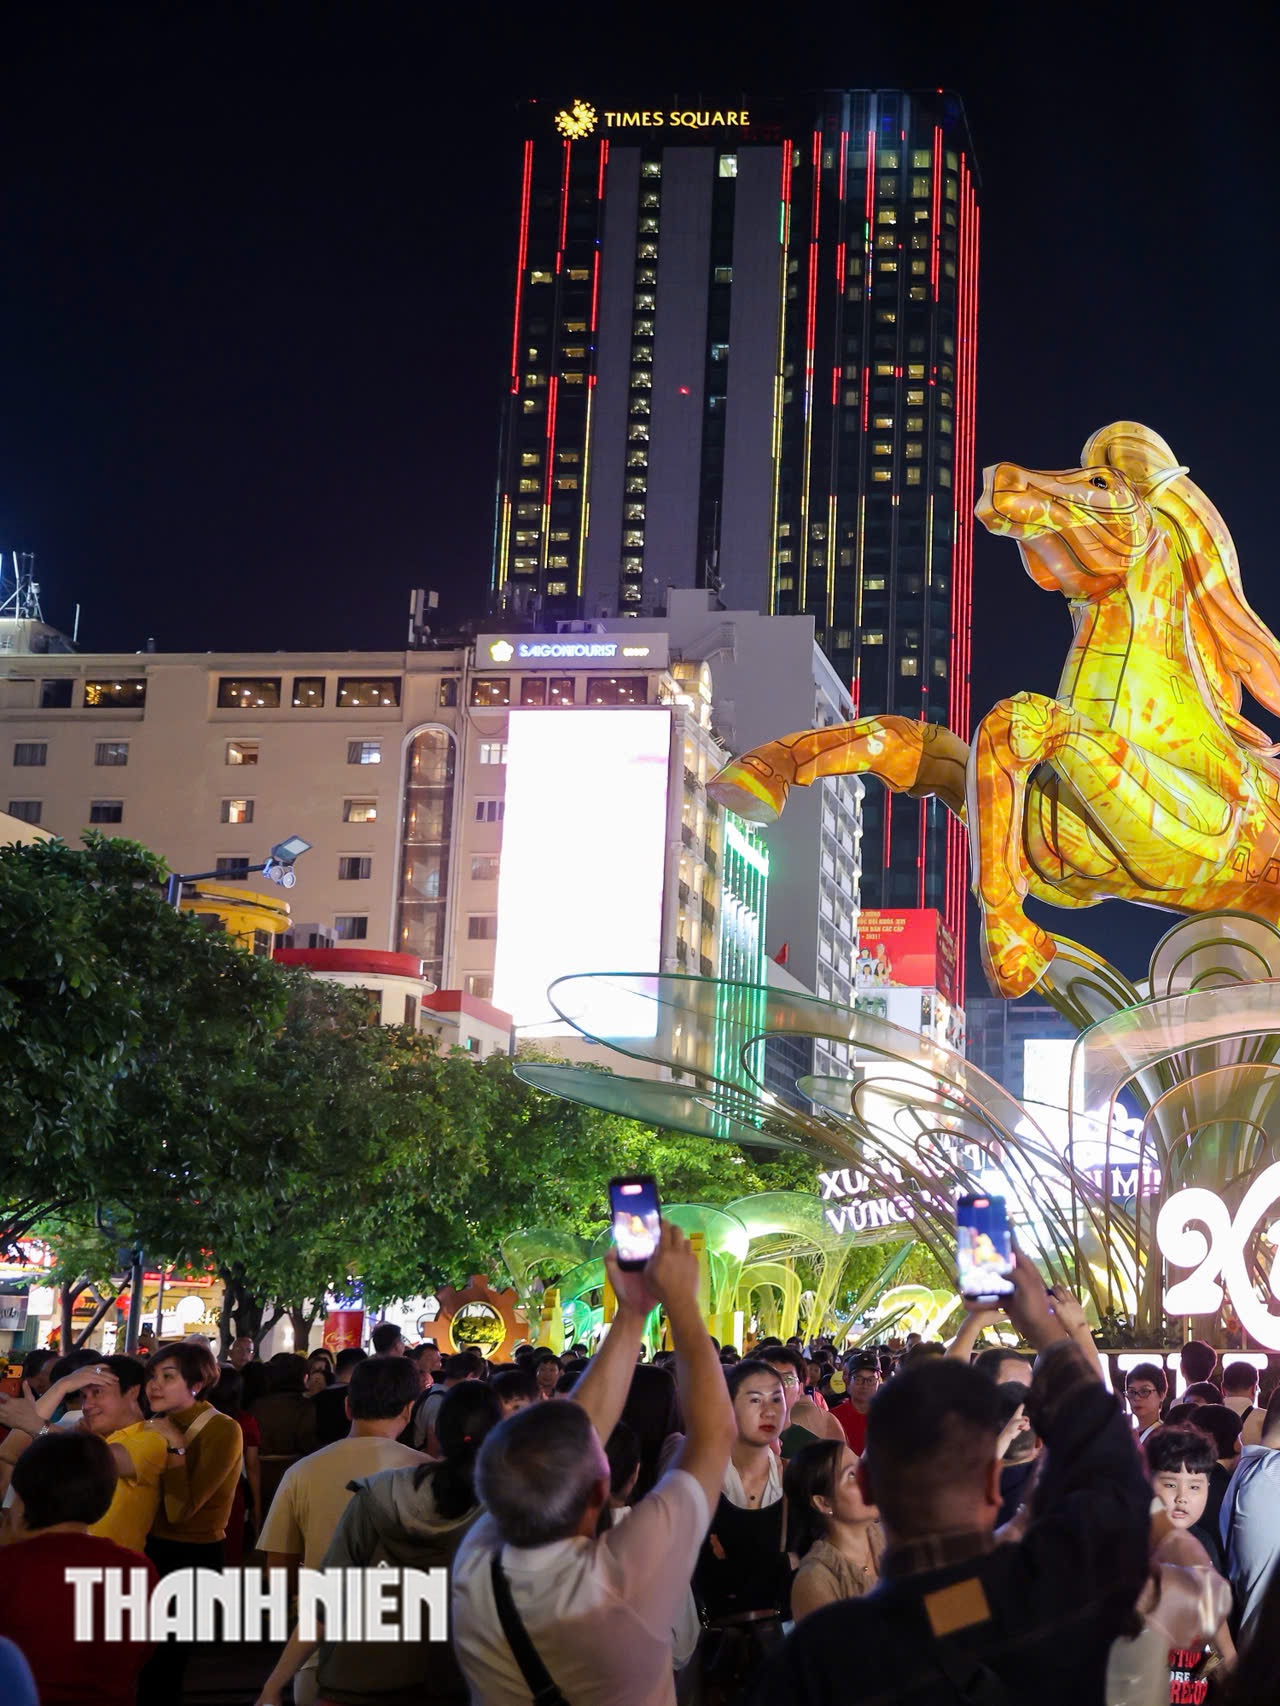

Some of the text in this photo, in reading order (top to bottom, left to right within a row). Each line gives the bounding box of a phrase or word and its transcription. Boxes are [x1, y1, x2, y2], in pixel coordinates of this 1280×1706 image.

[604, 110, 750, 128] TIMES SQUARE
[518, 643, 618, 657] SAIGONTOURIST
